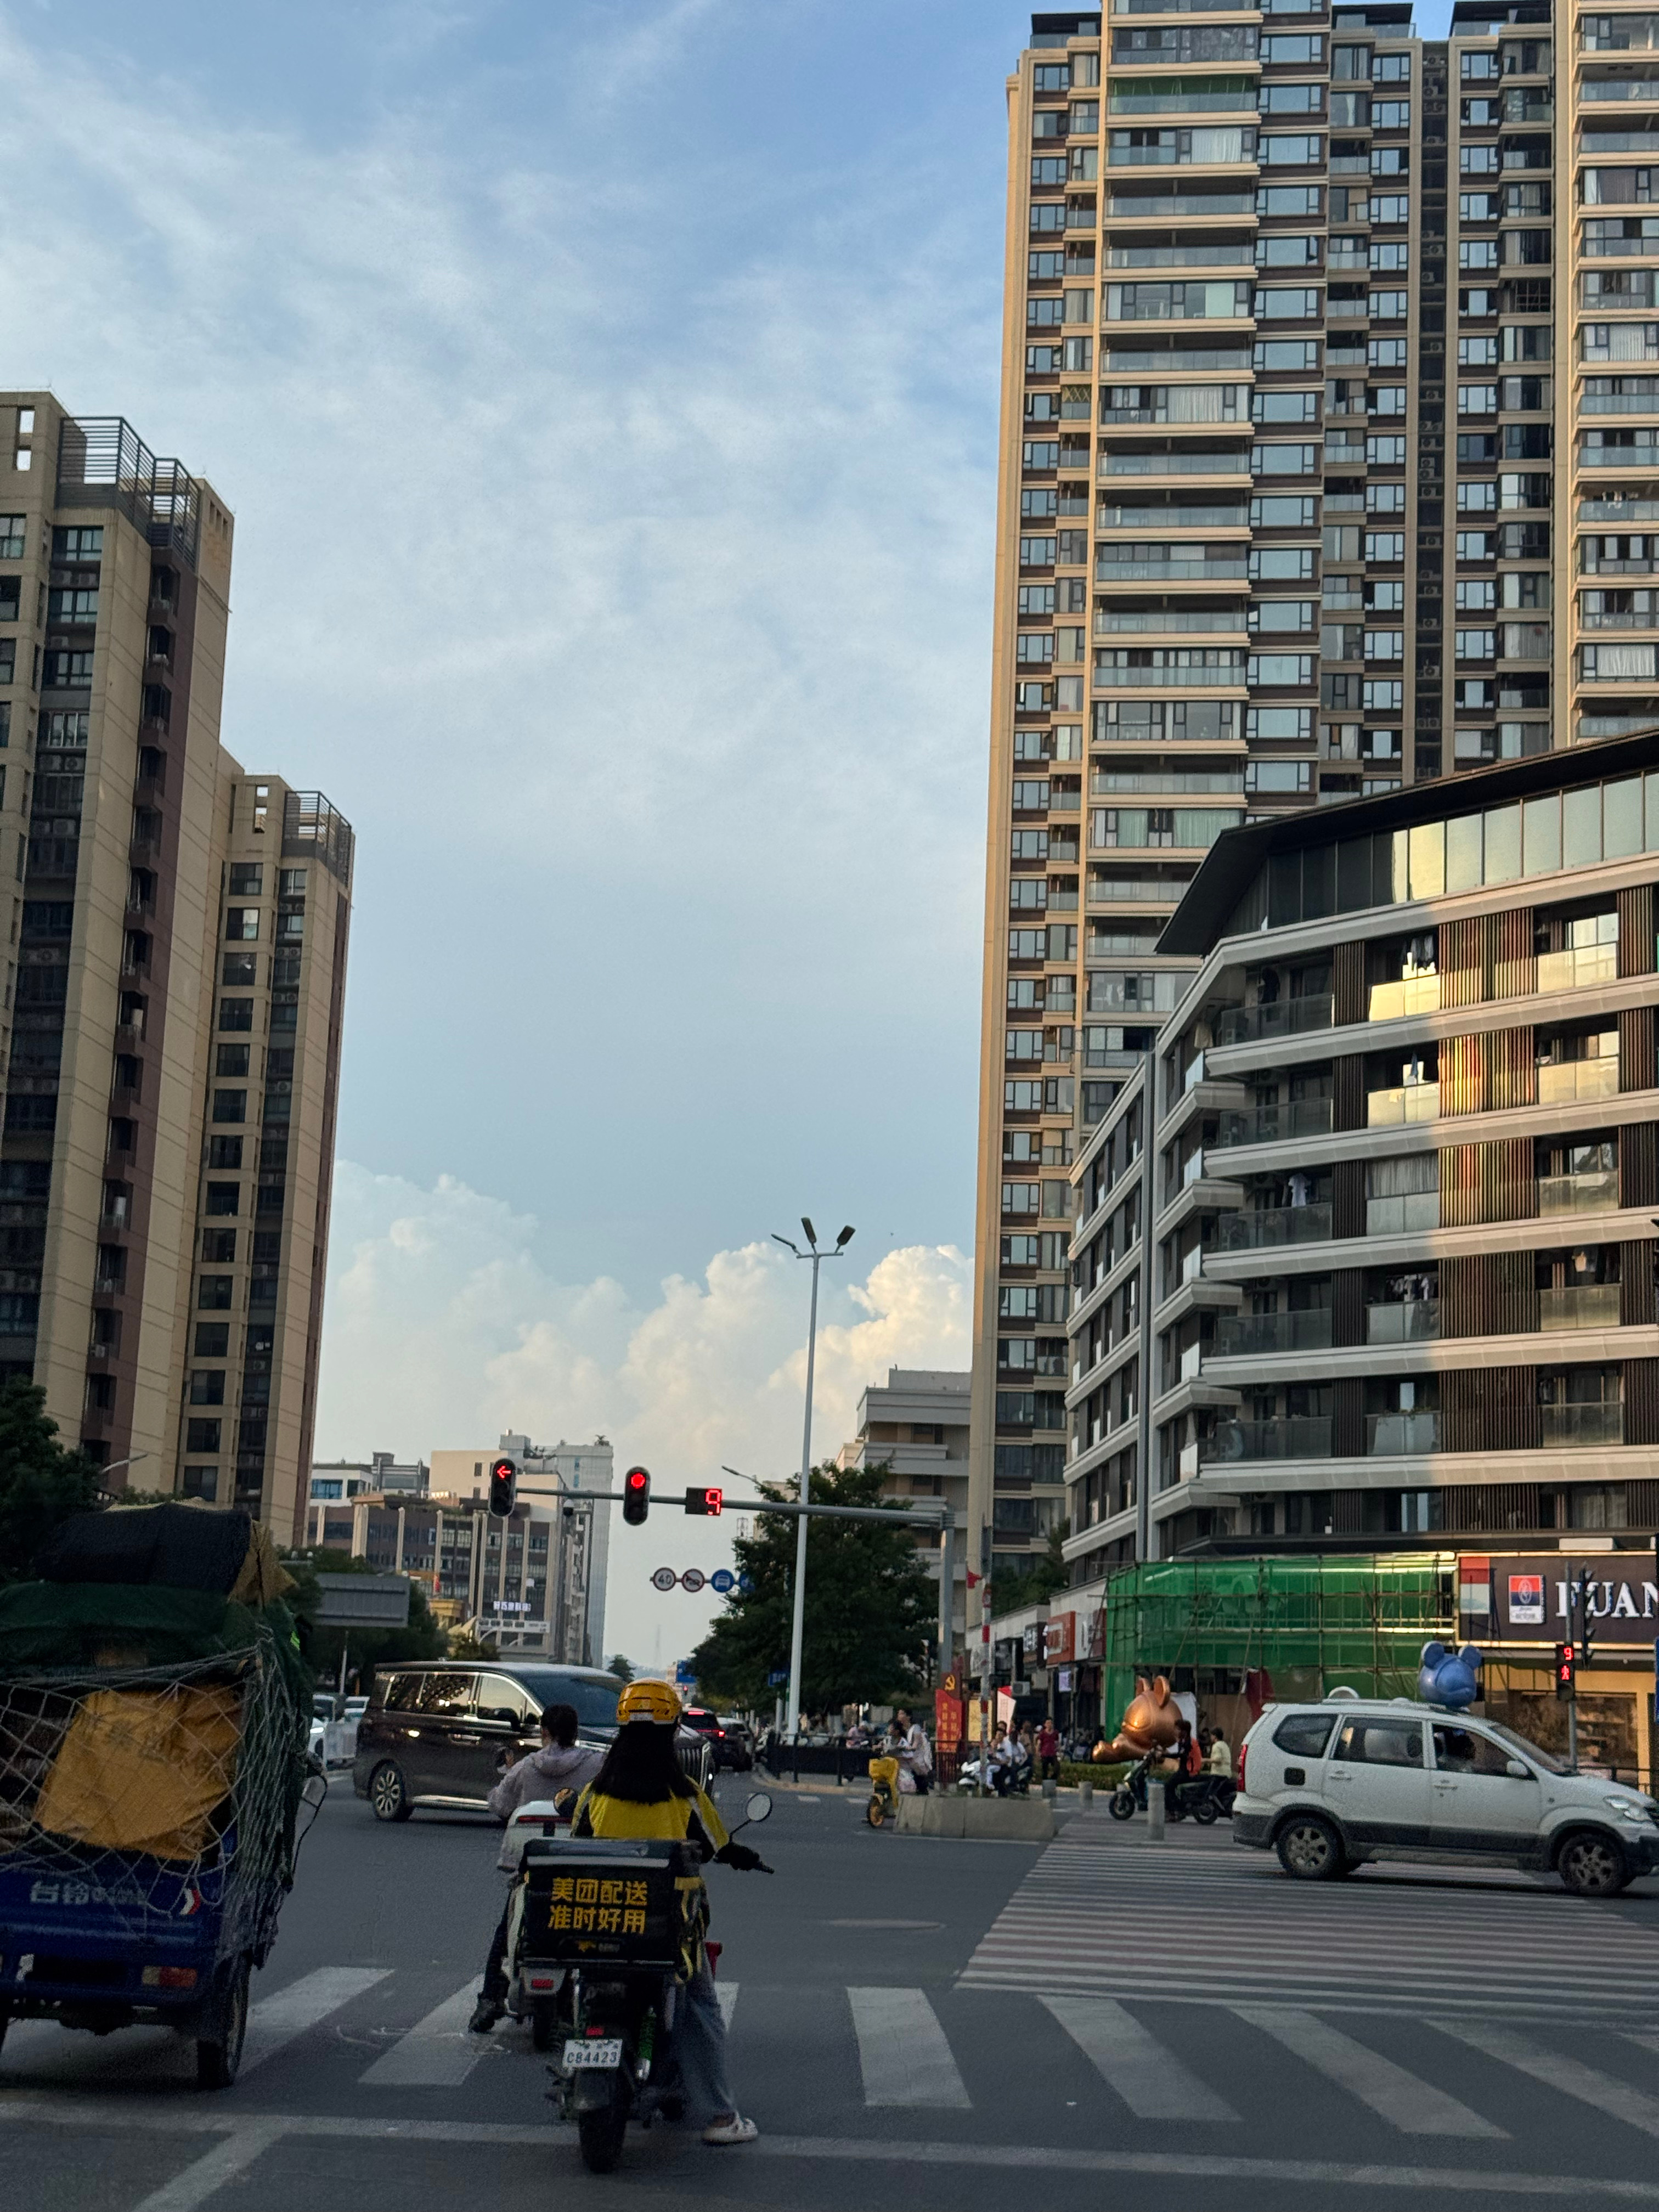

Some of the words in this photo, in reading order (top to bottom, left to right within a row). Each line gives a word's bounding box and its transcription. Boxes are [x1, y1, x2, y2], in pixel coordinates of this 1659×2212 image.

[706, 1489, 721, 1515] 9
[658, 1573, 673, 1585] 40
[550, 1877, 648, 1905] 美团配送
[548, 1905, 646, 1934] 准时好用
